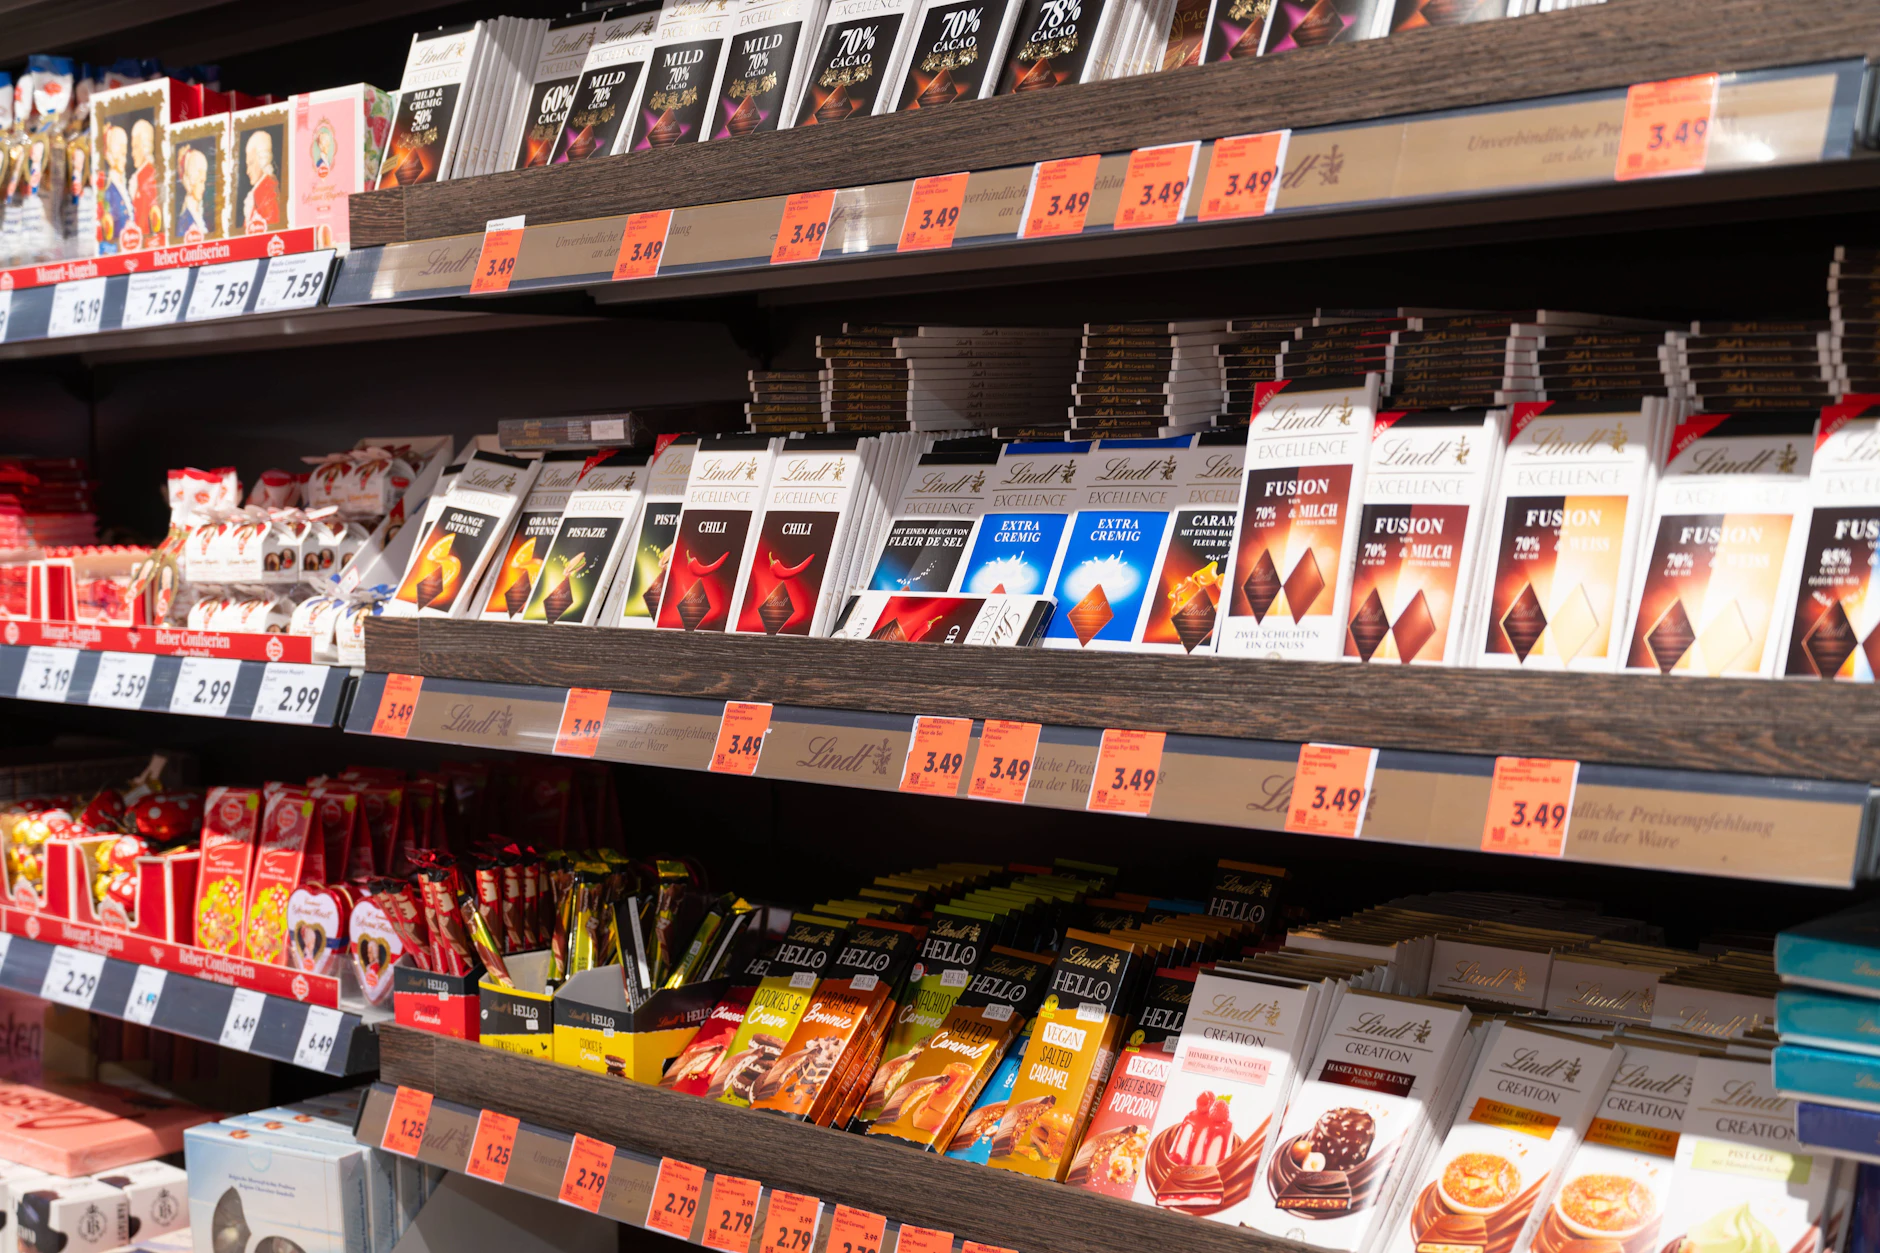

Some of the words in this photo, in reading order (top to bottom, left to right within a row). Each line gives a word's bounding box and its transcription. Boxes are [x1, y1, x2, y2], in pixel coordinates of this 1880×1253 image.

[940, 7, 984, 41] 70%
[1038, 0, 1082, 30] 78%
[742, 33, 783, 54] MILD
[837, 25, 879, 57] 70%
[1030, 23, 1076, 43] CACAO
[933, 36, 976, 53] CACAO
[663, 49, 704, 68] MILD
[588, 71, 626, 89] MILD
[666, 82, 687, 91] CACAO
[410, 97, 442, 111] CREMIG
[414, 90, 435, 101] MILD
[541, 84, 575, 113] 60%
[413, 109, 433, 126] 50%
[1047, 192, 1089, 216] 3.49
[920, 206, 959, 230] 3.49
[555, 230, 618, 249] Unverbindliche
[790, 221, 827, 244] 3.49
[153, 248, 180, 266] Reber
[180, 243, 230, 264] Confiserien
[591, 247, 604, 260] an
[604, 245, 619, 258] der
[36, 262, 98, 283] Mozart-Kugeln
[210, 280, 249, 308] 7.59
[282, 271, 324, 300] 7.59
[73, 298, 100, 325] 15.19
[145, 289, 182, 316] 7.59
[1258, 440, 1348, 459] EXCELLENCE
[1088, 491, 1168, 504] EXCELLENCE
[1264, 478, 1330, 497] FUSION
[904, 502, 976, 515] EXCELLENCE
[993, 494, 1067, 507] EXCELLENCE
[450, 512, 486, 529] ORANGE
[1255, 506, 1277, 520] 70%
[1288, 509, 1297, 518] &
[1299, 503, 1338, 518] MILCH
[1525, 508, 1602, 528] FUSION
[445, 522, 480, 537] INTENSE
[566, 527, 607, 539] PISTAZIE
[698, 521, 728, 534] CHILI
[781, 522, 813, 536] CHILI
[893, 527, 905, 535] MIT
[905, 528, 927, 536] EINEM
[927, 528, 953, 536] HAUCH
[953, 528, 969, 536] VON
[1001, 520, 1040, 531] EXTRA
[1098, 518, 1139, 530] EXTRA
[1180, 529, 1193, 537] MIT
[1194, 529, 1218, 537] EINEM
[1374, 517, 1445, 535] FUSION
[888, 536, 923, 547] FLEUR
[925, 536, 940, 547] DE
[942, 537, 964, 547] SEL
[994, 532, 1042, 543] CREMIG
[1090, 530, 1141, 542] CREMIG
[1193, 539, 1216, 547] FLEUR
[1515, 536, 1540, 553] 70%
[1679, 526, 1764, 546] FUSION
[1364, 543, 1387, 558] 70%
[1410, 544, 1453, 560] MILCH
[41, 624, 102, 643] Mozart-Kugeln
[155, 630, 180, 647] Reber
[181, 632, 230, 650] Confiserien
[1234, 631, 1259, 640] ZWEI
[1260, 630, 1320, 639] SCHICHTEN
[1245, 641, 1263, 649] EIN
[1265, 641, 1305, 650] GENUSS
[40, 667, 70, 691] 3.19
[112, 674, 147, 698] 3.59
[193, 679, 231, 705] 2.99
[278, 686, 320, 712] 2.99
[645, 722, 719, 743] Preisempfehlung
[616, 738, 628, 748] an
[629, 738, 646, 750] der
[647, 740, 669, 752] Ware
[728, 735, 762, 755] 3.49
[923, 752, 963, 774] 3.49
[989, 757, 1030, 781] 3.49
[1029, 778, 1045, 791] an
[1045, 778, 1068, 793] der
[1111, 768, 1155, 792] 3.49
[1312, 785, 1361, 812] 3.49
[1511, 801, 1566, 828] 3.49
[1629, 806, 1775, 837] Preisempfehlung
[1577, 827, 1599, 843] an
[1602, 827, 1630, 846] der
[1637, 829, 1681, 850] Ware
[775, 944, 827, 968] HELLO
[837, 947, 890, 971] HELLO
[921, 938, 977, 965] HELLO
[179, 950, 203, 968] Reber
[204, 954, 255, 979] Confiserien
[63, 971, 96, 997] 2.29
[967, 974, 1027, 1002] HELLO
[1052, 970, 1112, 1000] HELLO
[754, 988, 794, 1012] COOKIES
[794, 996, 802, 1014] &
[817, 991, 861, 1015] CARAMEL
[233, 1014, 255, 1032] 6.49
[591, 1013, 615, 1028] HELLO
[748, 1006, 787, 1028] Cream
[803, 1004, 852, 1029] Brownie
[948, 1017, 993, 1044] SALTED
[1046, 1025, 1083, 1049] VEGAN
[1203, 1027, 1266, 1049] CREATION
[308, 1033, 333, 1051] 6.49
[930, 1031, 990, 1060] Caramel
[1040, 1045, 1073, 1069] SALTED
[1187, 1050, 1219, 1064] HIMBEER
[1219, 1055, 1243, 1068] PANNA
[1243, 1060, 1268, 1072] COTTA
[1345, 1042, 1413, 1064] CREATION
[1029, 1063, 1070, 1091] CARAMEL
[1130, 1058, 1168, 1078] VEGAN
[1326, 1062, 1374, 1080] HASELNUSS
[1374, 1072, 1387, 1081] DE
[1387, 1074, 1412, 1087] LUXE
[1113, 1076, 1140, 1093] SWEET
[1147, 1080, 1165, 1097] SALT
[1350, 1075, 1379, 1088] Feinherb
[1496, 1079, 1561, 1105] CREATION
[1108, 1093, 1158, 1120] POPCORN
[1606, 1096, 1686, 1122] CREATION
[400, 1118, 423, 1139] 1.25
[486, 1143, 511, 1166] 1.25
[576, 1168, 605, 1194] 2.79
[686, 1184, 699, 1192] 3.99
[665, 1192, 696, 1218] 2.79
[741, 1199, 754, 1208] 3.99
[720, 1209, 753, 1234] 2.79
[799, 1216, 812, 1225] 3.99
[777, 1226, 811, 1251] 2.79
[864, 1233, 878, 1242] 3.99
